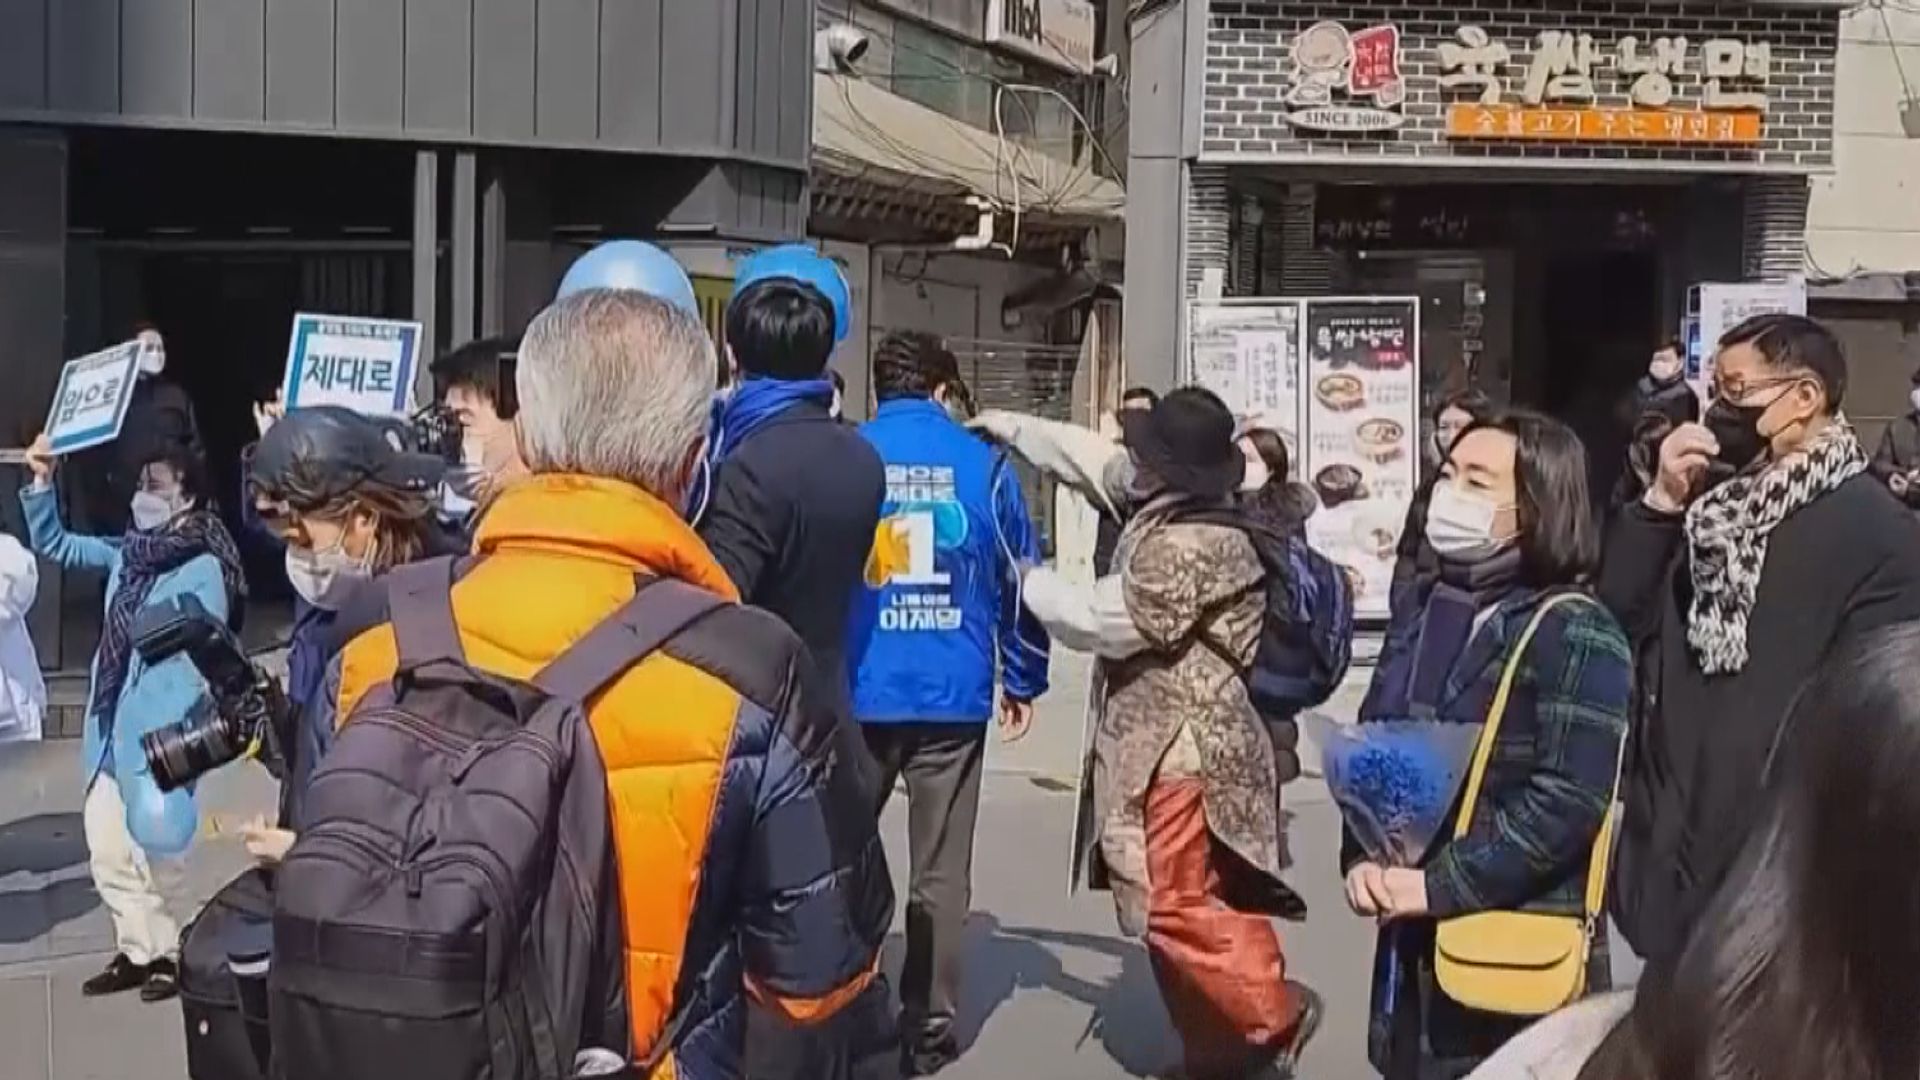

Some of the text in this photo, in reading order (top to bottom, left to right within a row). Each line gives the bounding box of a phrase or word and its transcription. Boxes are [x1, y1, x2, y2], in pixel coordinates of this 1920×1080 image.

[1437, 25, 1770, 107] 육쌈냉면
[1304, 111, 1389, 125] SINCE 2006
[306, 354, 393, 394] 제대로
[61, 377, 120, 422] 앞으로
[890, 510, 951, 585] 1
[880, 608, 962, 630] 이재명
